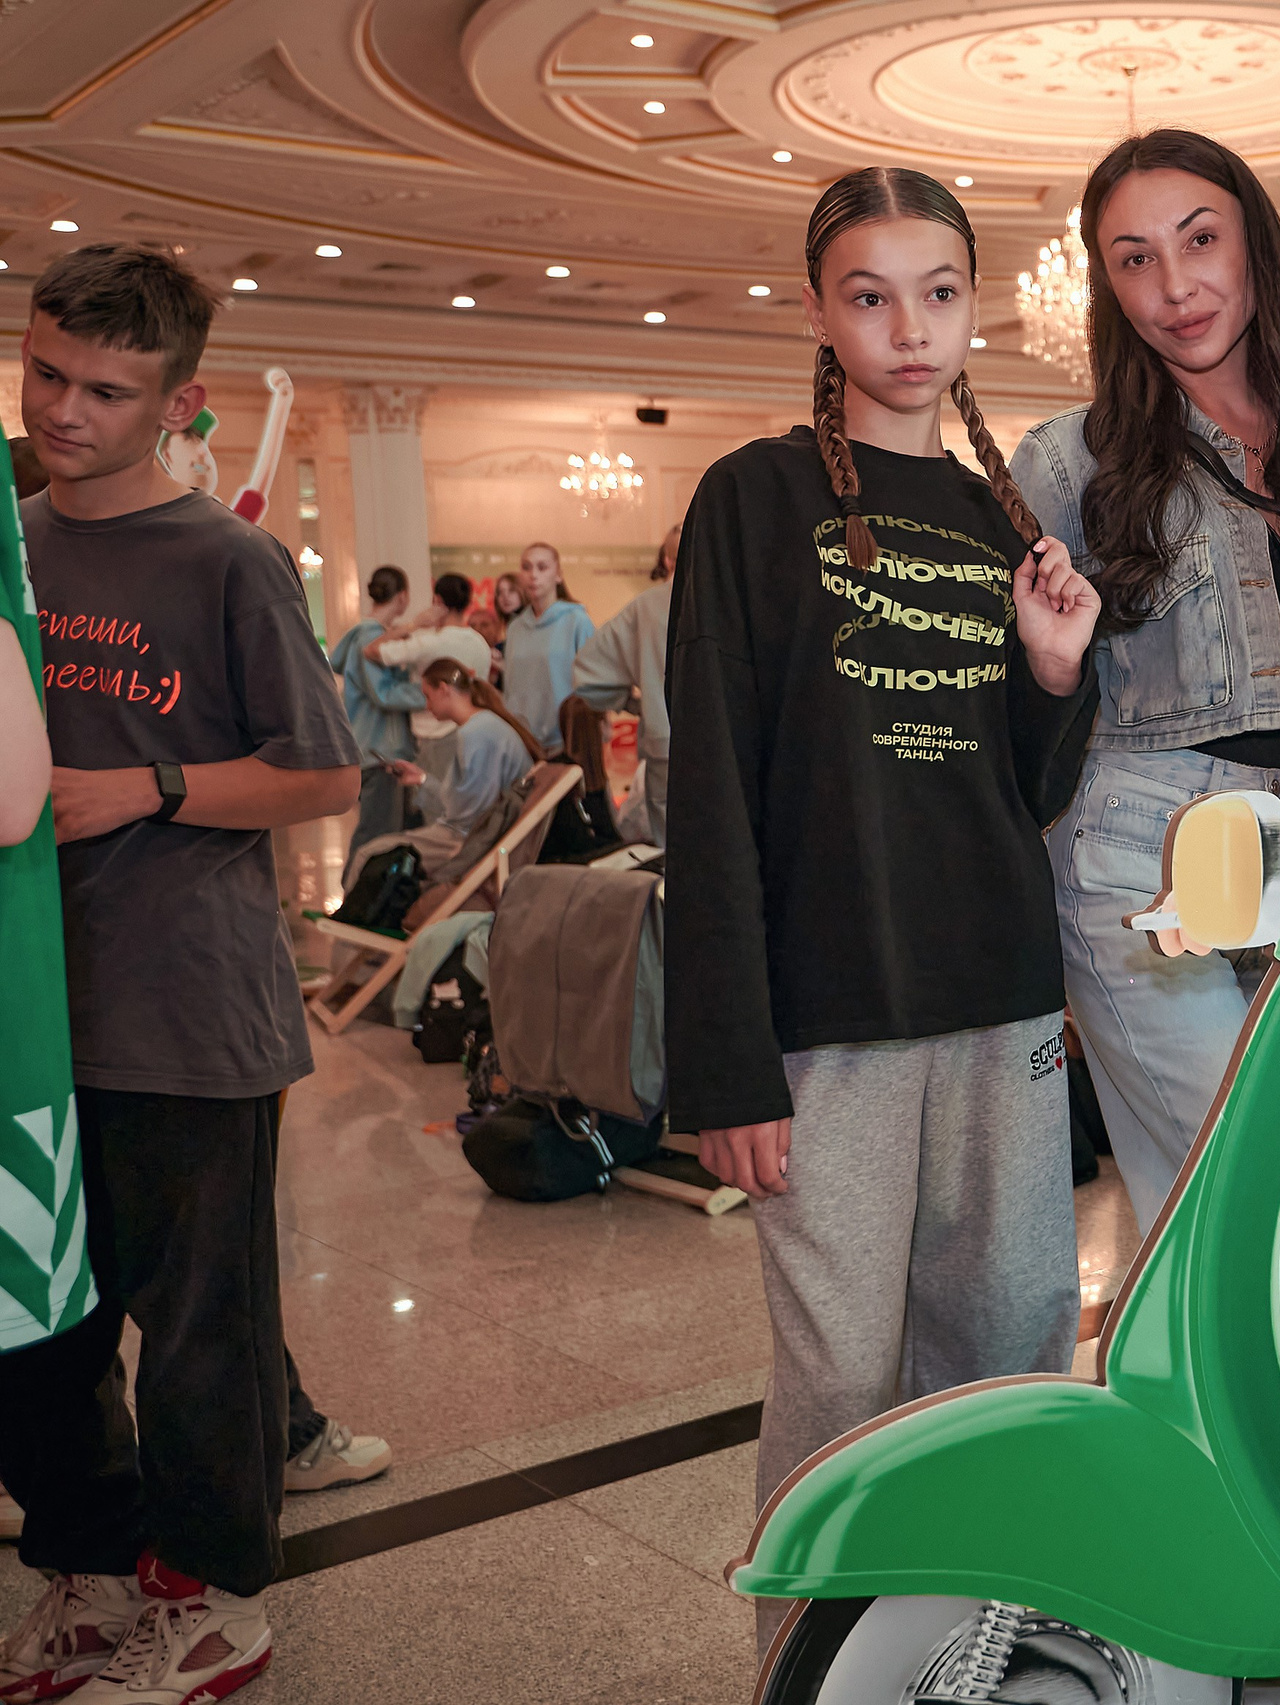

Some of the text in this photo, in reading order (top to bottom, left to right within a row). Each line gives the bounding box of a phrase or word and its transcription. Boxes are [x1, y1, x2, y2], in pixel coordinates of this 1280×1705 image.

[892, 722, 953, 738] СТУДИЯ
[872, 733, 979, 752] СОВРЕМЕННОГО
[895, 748, 945, 762] ТАНЦА
